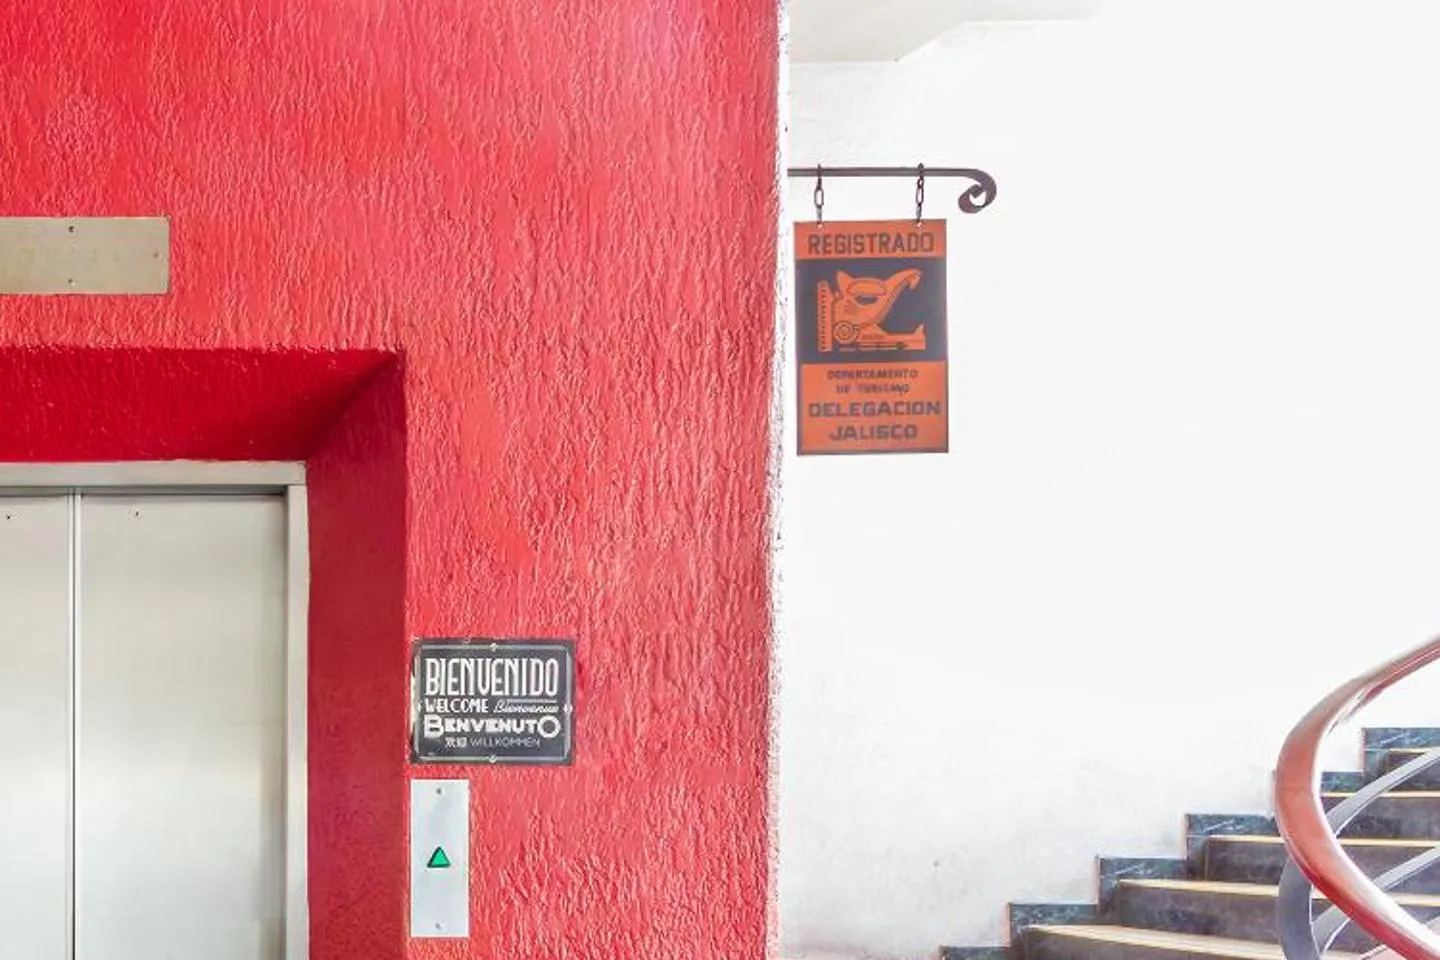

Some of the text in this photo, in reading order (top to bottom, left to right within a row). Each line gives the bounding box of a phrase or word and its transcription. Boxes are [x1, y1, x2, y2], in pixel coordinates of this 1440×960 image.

[808, 232, 933, 255] REGISTRADO
[809, 401, 940, 417] DELEGACION
[830, 423, 918, 441] JALISCO
[425, 658, 559, 696] BIENVENIDO
[425, 698, 489, 713] WELCOME
[470, 736, 540, 748] WILLKOMMEN
